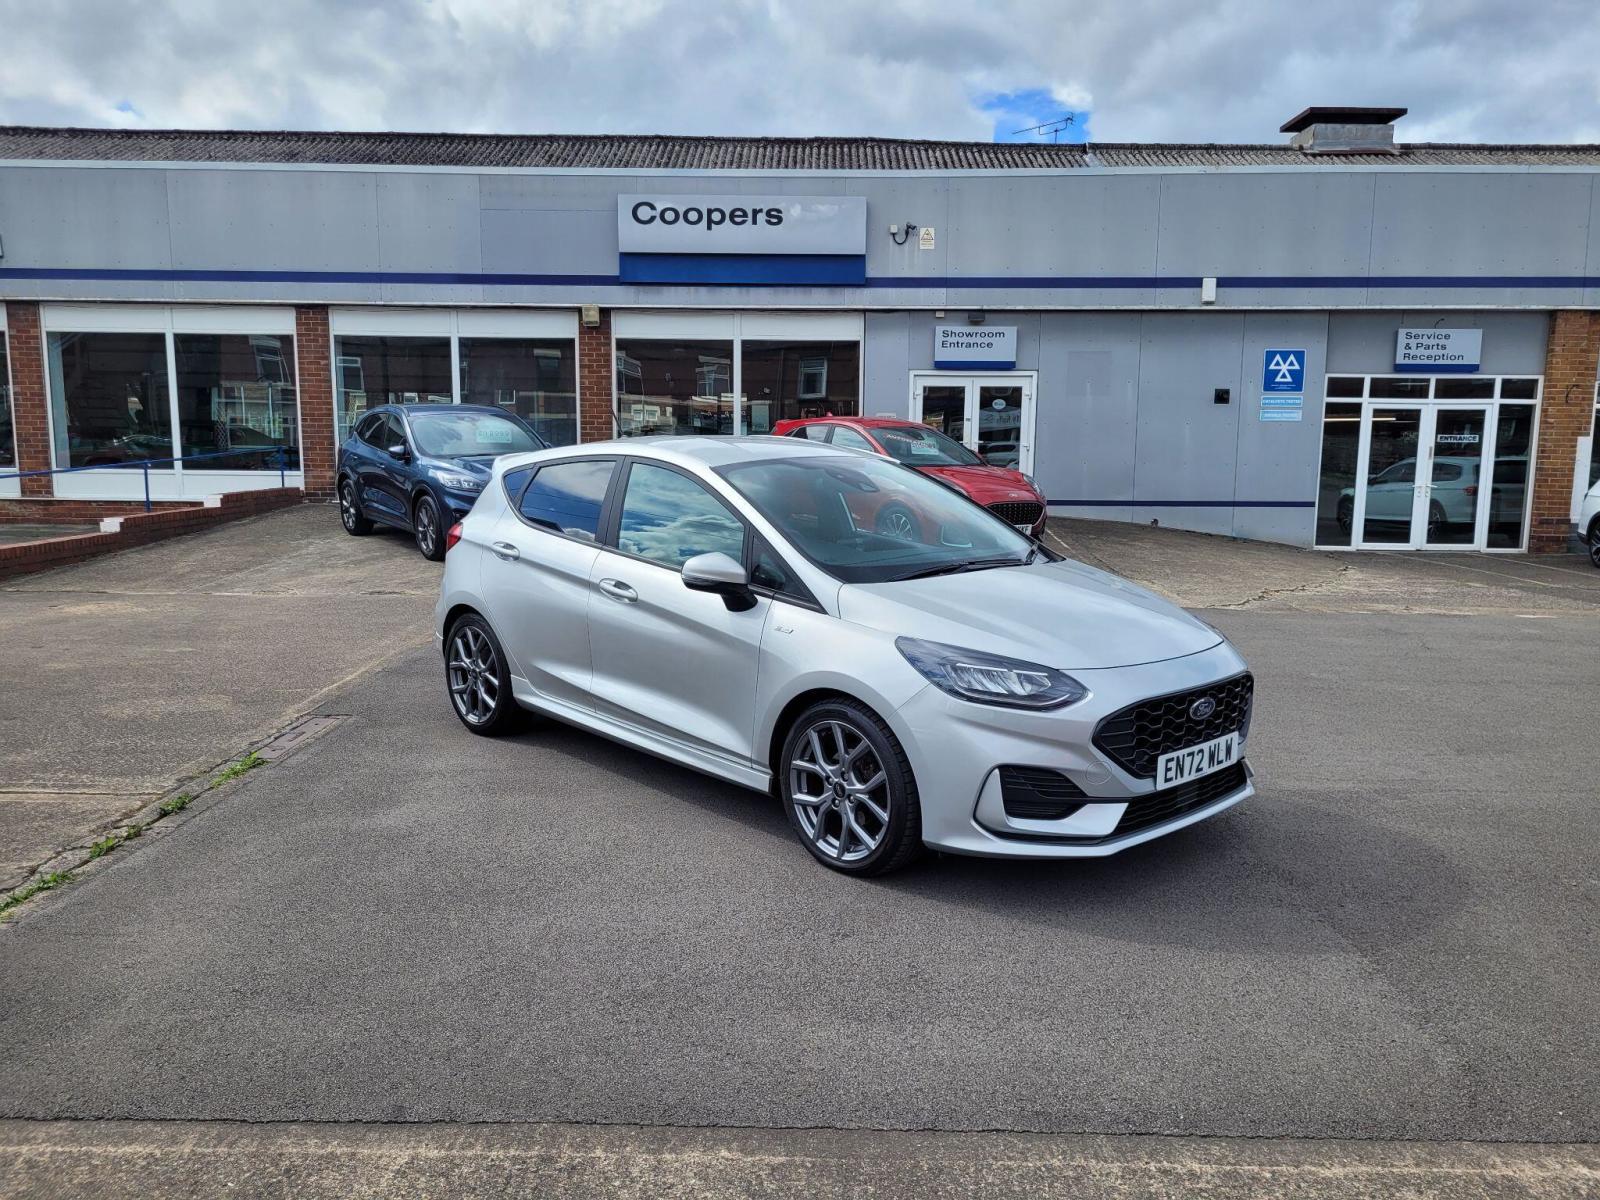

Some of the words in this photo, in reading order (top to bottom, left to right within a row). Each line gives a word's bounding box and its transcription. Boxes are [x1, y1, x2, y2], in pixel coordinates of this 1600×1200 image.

[632, 201, 783, 231] Coopers
[942, 329, 1005, 338] Showroom
[1405, 331, 1451, 340] Service
[941, 340, 994, 349] Entrance
[1404, 342, 1412, 350] &
[1416, 342, 1447, 351] Parts
[1403, 352, 1464, 362] Reception
[1164, 748, 1204, 784] EN72
[1208, 737, 1233, 769] WLW
